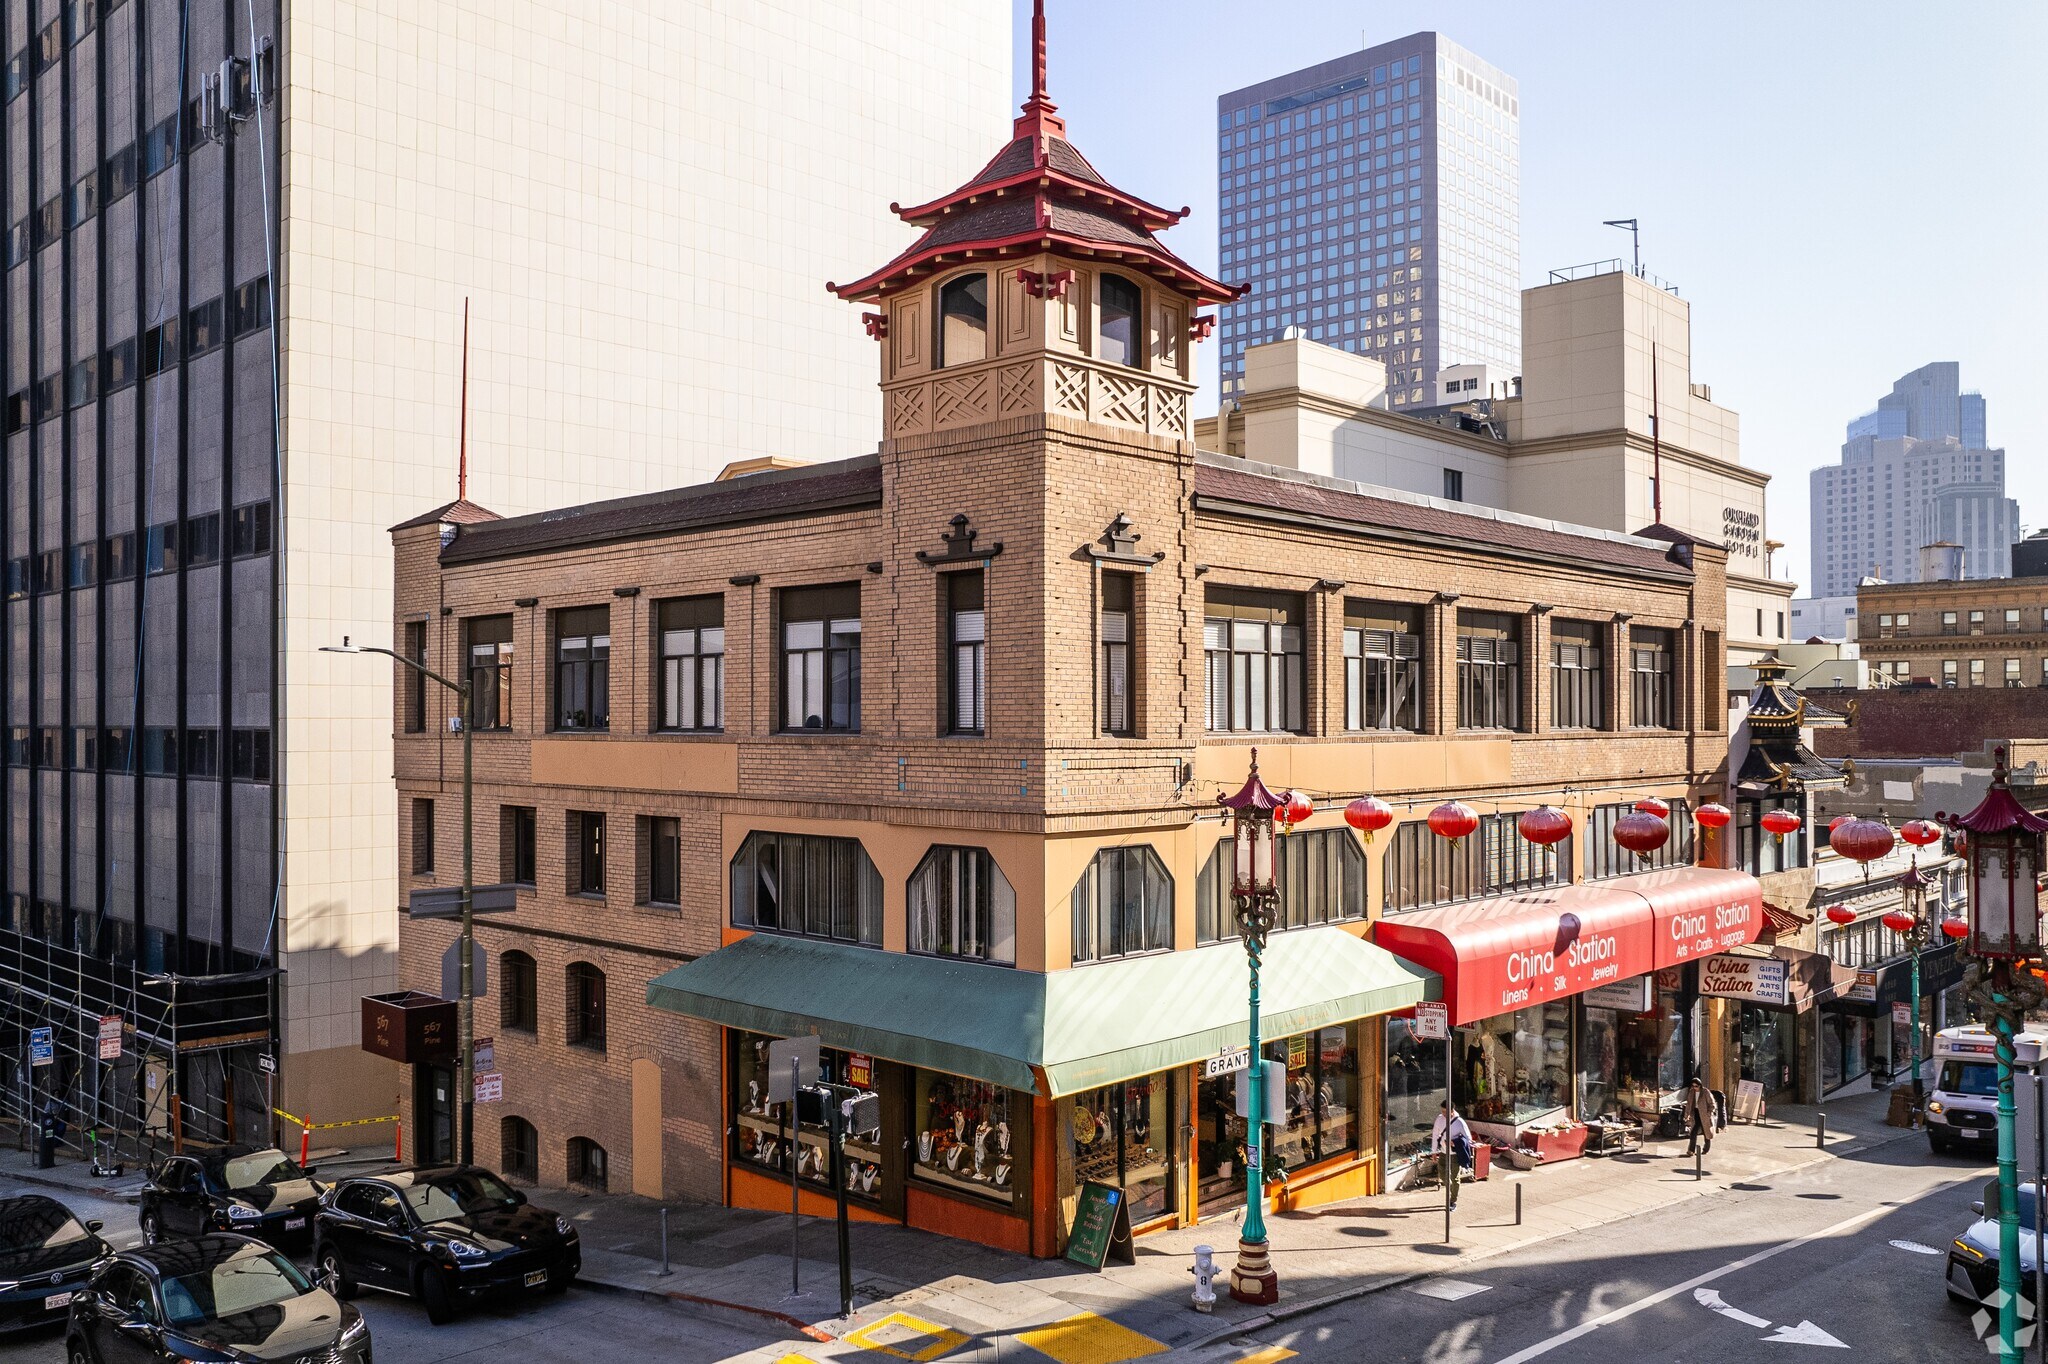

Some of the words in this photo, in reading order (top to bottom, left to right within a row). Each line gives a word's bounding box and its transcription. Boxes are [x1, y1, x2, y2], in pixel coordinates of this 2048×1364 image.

[1672, 913, 1706, 940] China
[1715, 902, 1750, 930] Station
[1676, 943, 1688, 958] Arts
[1696, 936, 1713, 952] Crafts
[1721, 929, 1745, 946] Luggage
[1507, 949, 1554, 983] China
[1568, 935, 1616, 968] Station
[1707, 958, 1750, 974] China
[1759, 965, 1781, 974] GIFTS
[1502, 987, 1529, 1006] Linens
[1554, 974, 1567, 991] Silk
[1591, 962, 1618, 981] Jewelry
[1702, 975, 1753, 993] Station
[1757, 974, 1783, 982] LINENS
[1759, 982, 1780, 990] ARTS
[1756, 990, 1783, 999] CRAFTS
[1417, 1009, 1425, 1017] NO
[377, 1014, 389, 1031] 567
[424, 1022, 441, 1034] 567
[377, 1034, 389, 1047] Pine
[424, 1037, 441, 1045] Pine
[1210, 1053, 1248, 1073] GRANT
[1290, 1052, 1305, 1068] SALE
[851, 1067, 869, 1085] SALE
[1083, 1237, 1093, 1245] Ear
[1200, 1275, 1207, 1285] 8
